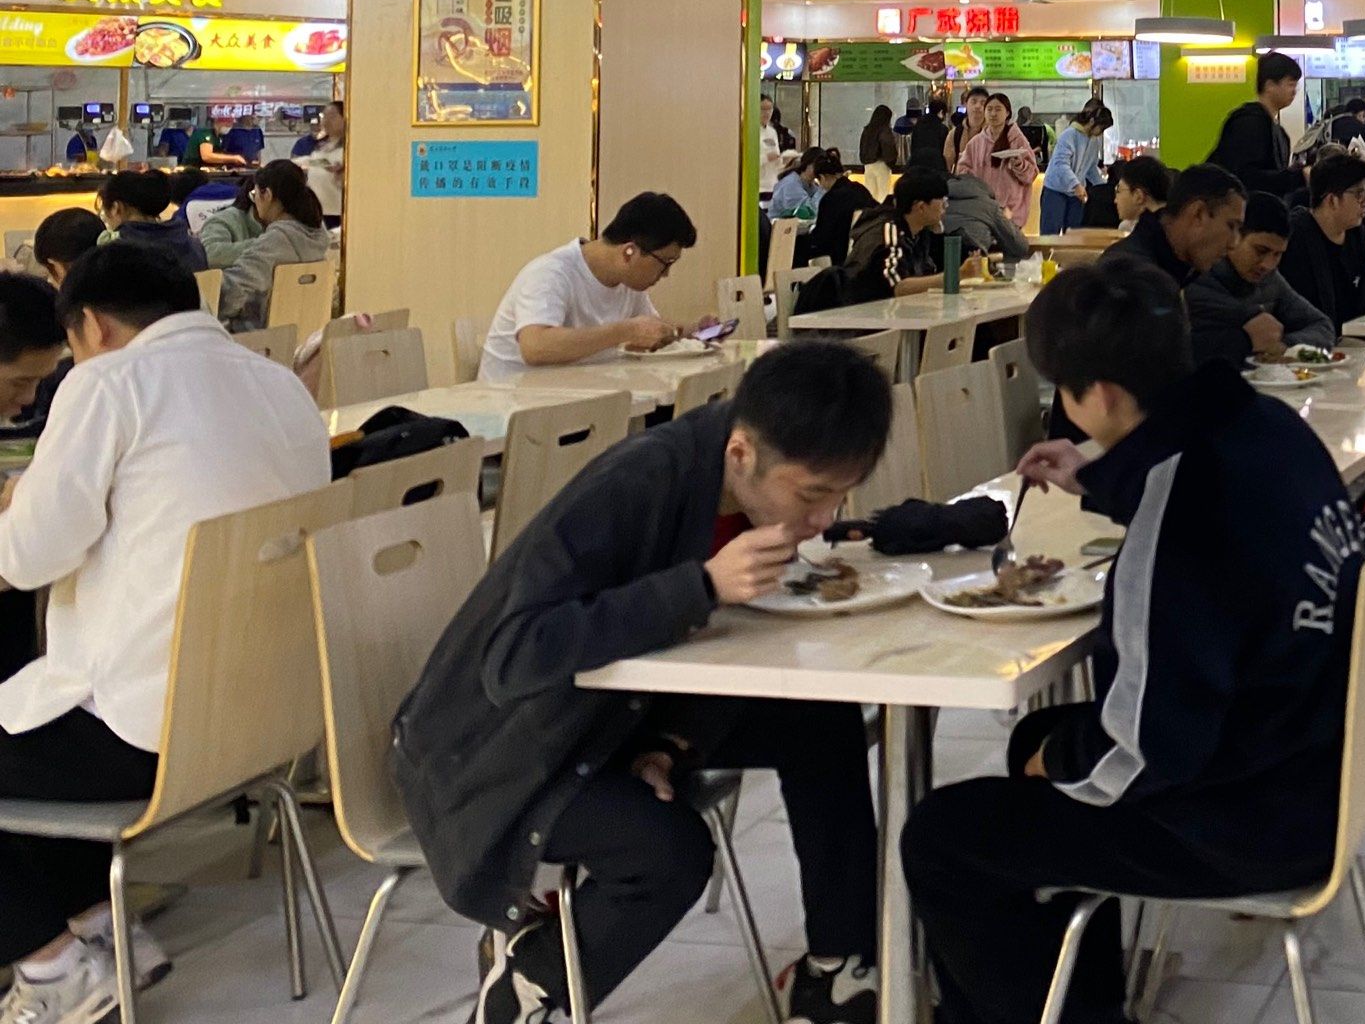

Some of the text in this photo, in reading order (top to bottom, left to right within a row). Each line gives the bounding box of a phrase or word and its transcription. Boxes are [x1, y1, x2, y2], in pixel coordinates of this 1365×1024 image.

[907, 6, 1019, 34] 广式烧腊
[209, 32, 276, 50] 大众美食
[419, 176, 530, 190] 传播的有效手段
